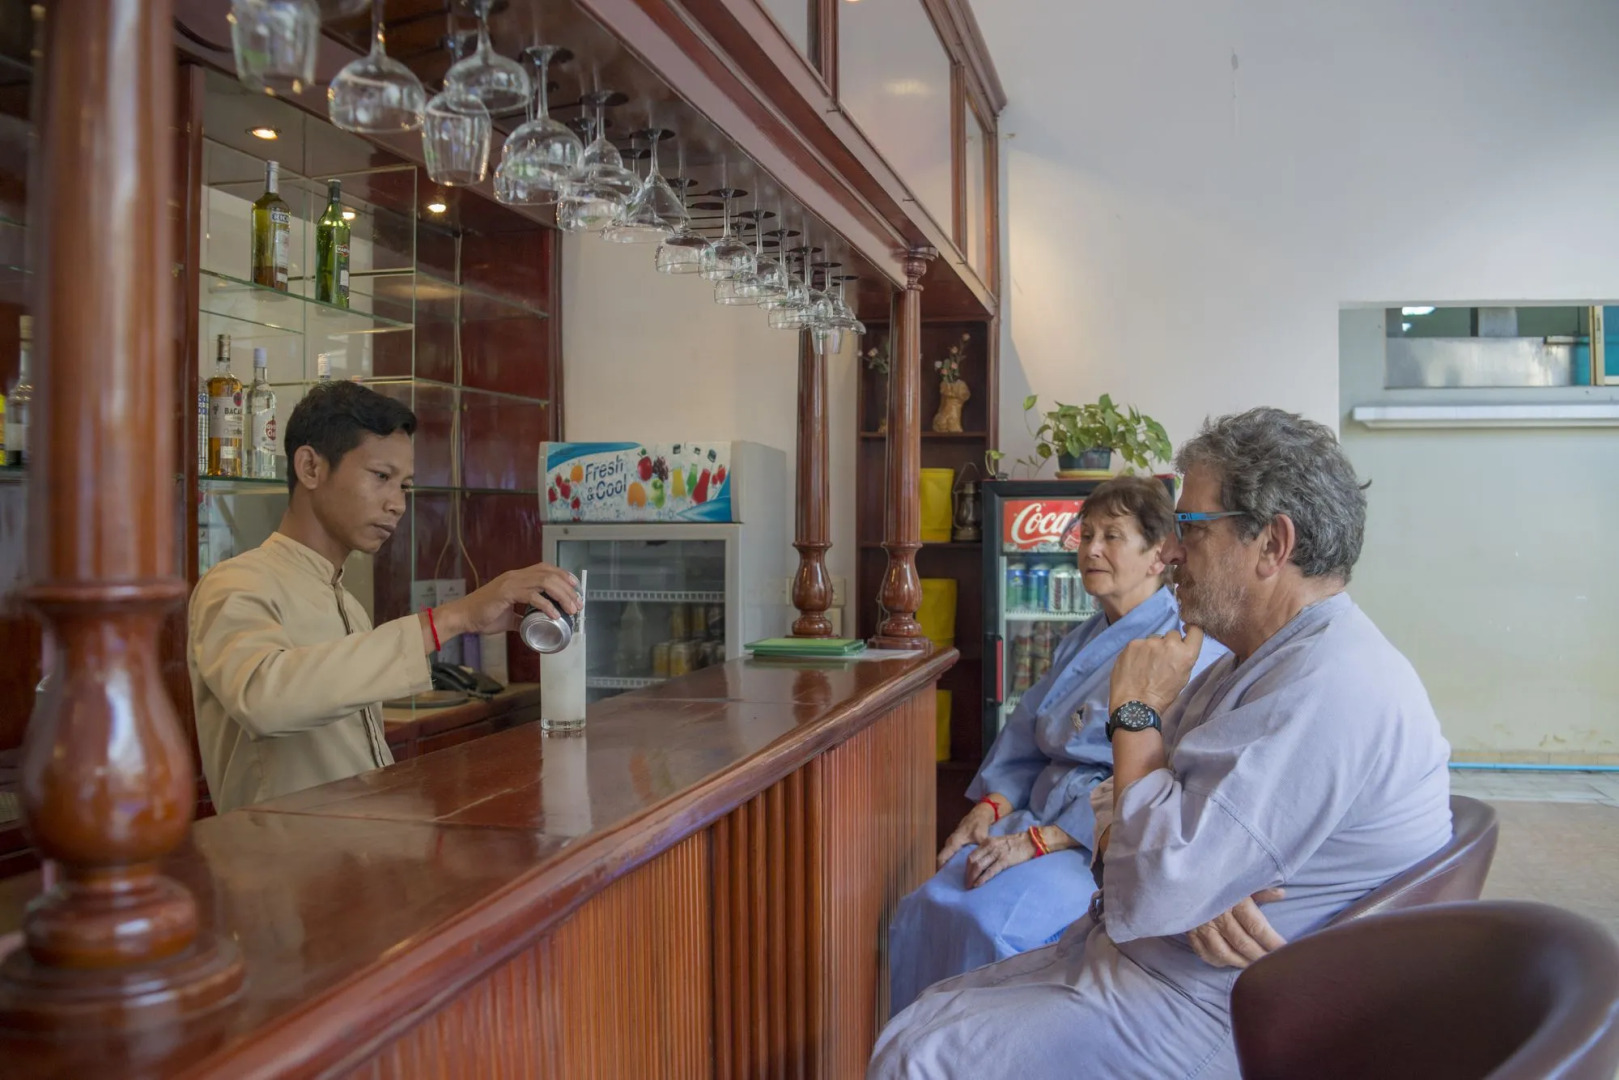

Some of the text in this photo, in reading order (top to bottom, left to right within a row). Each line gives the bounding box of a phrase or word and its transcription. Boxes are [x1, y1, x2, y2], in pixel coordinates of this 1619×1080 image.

[585, 455, 624, 484] Fresh
[587, 474, 627, 501] & Cool
